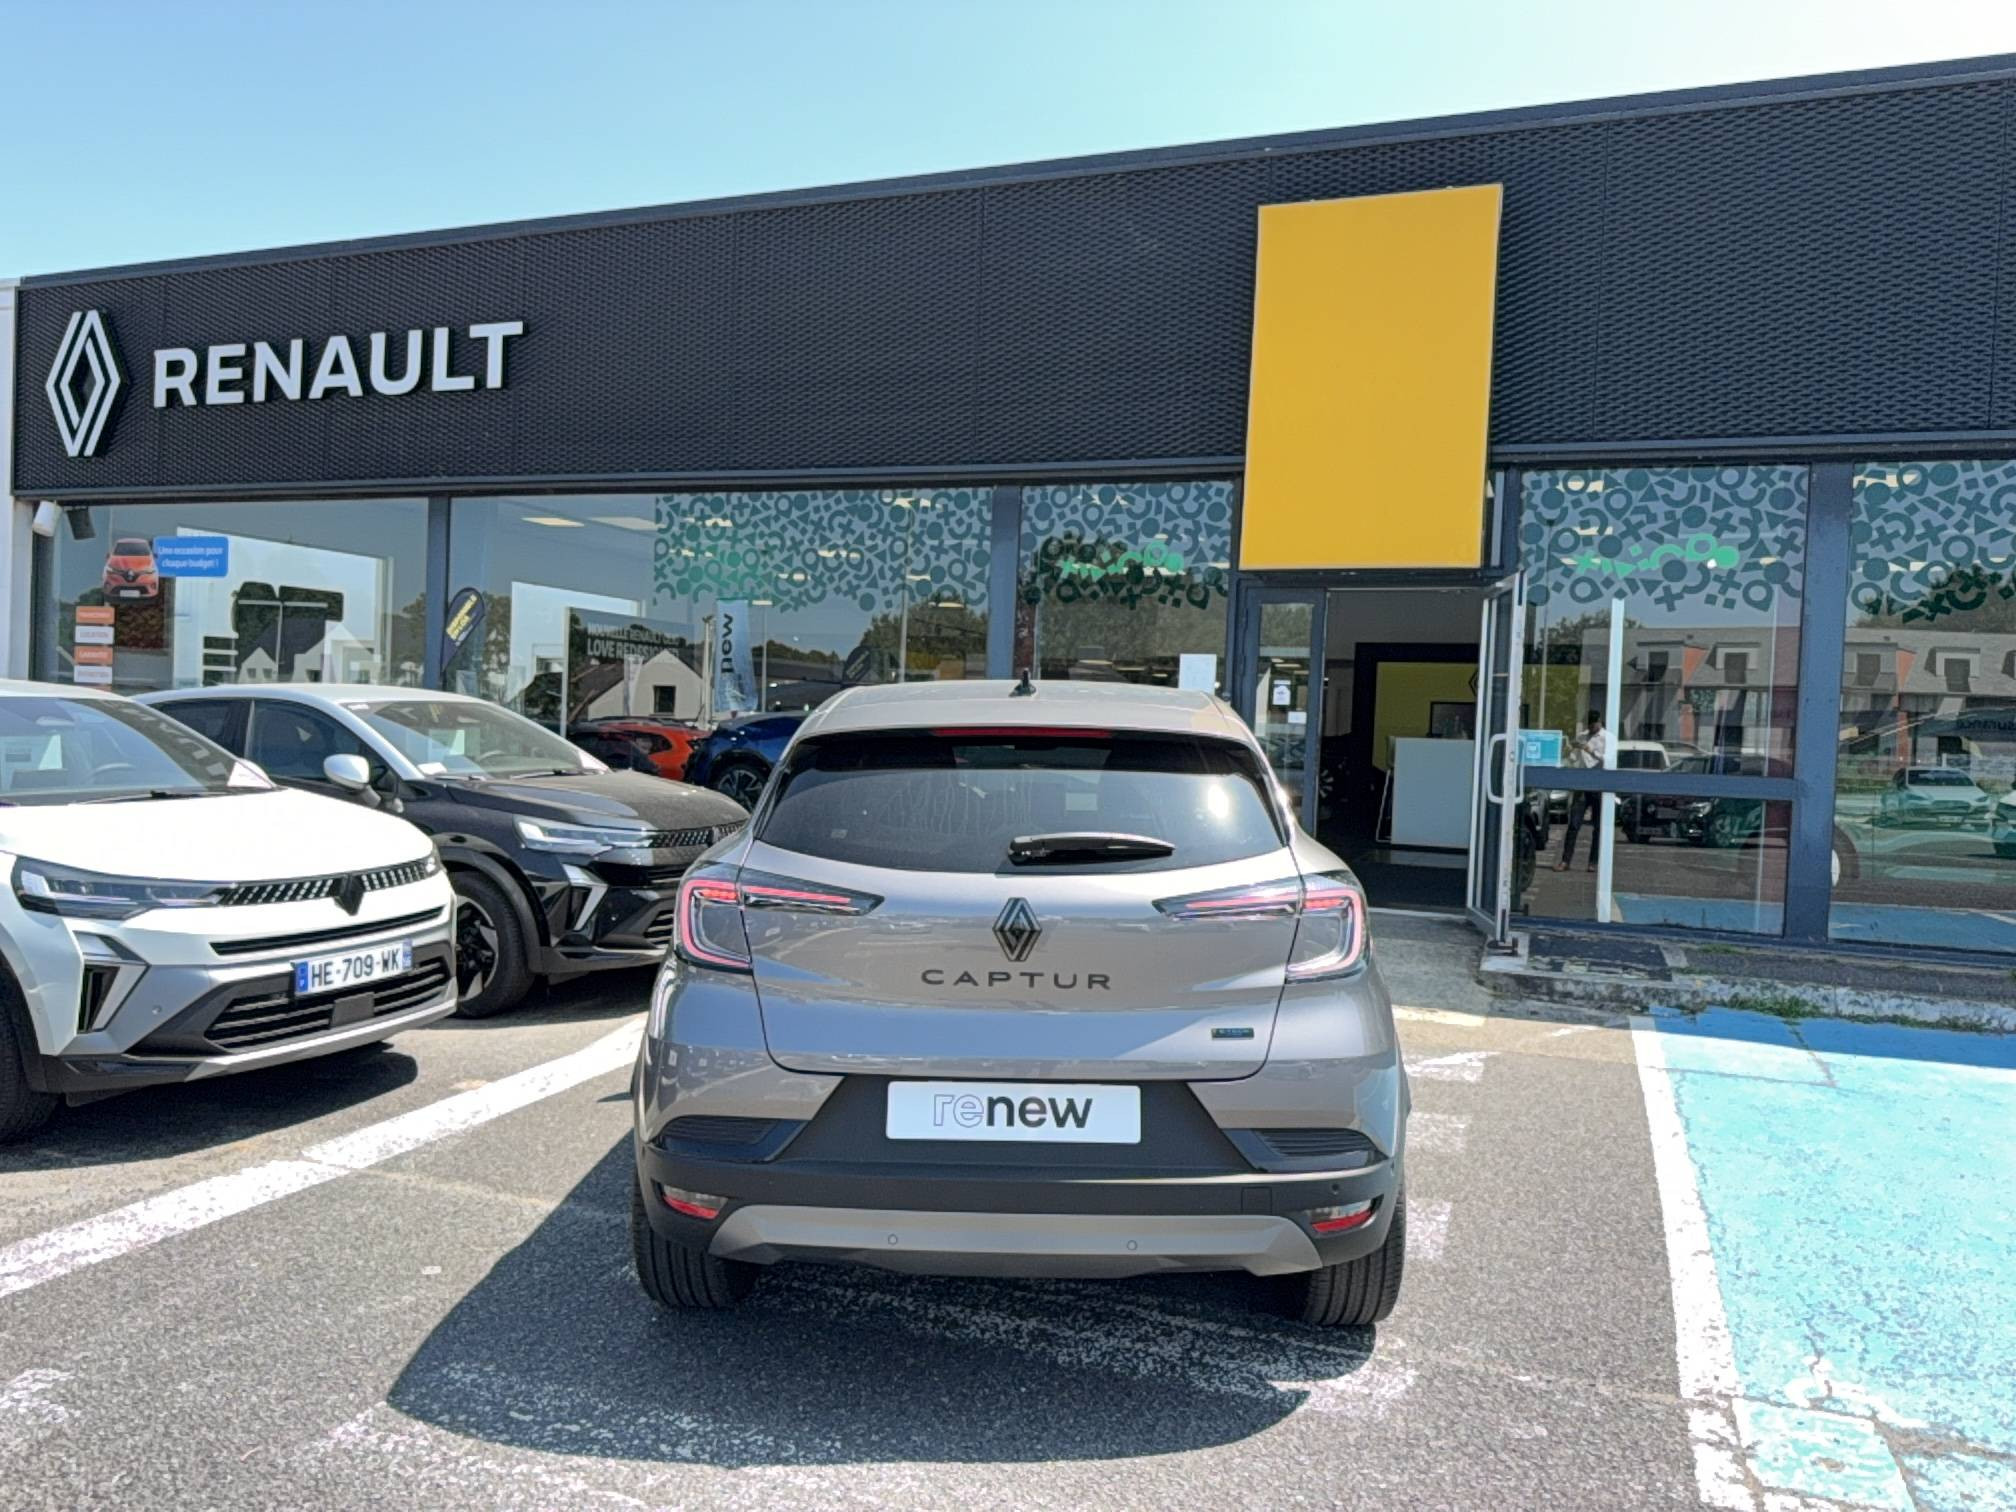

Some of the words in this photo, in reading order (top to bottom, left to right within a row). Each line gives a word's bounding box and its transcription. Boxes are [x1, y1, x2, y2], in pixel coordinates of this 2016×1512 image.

[153, 320, 524, 408] RENAULT
[587, 637, 615, 657] LOVE
[311, 949, 400, 987] HE-709-WK
[921, 969, 1111, 990] CAPTUR
[933, 1093, 1093, 1129] renew
